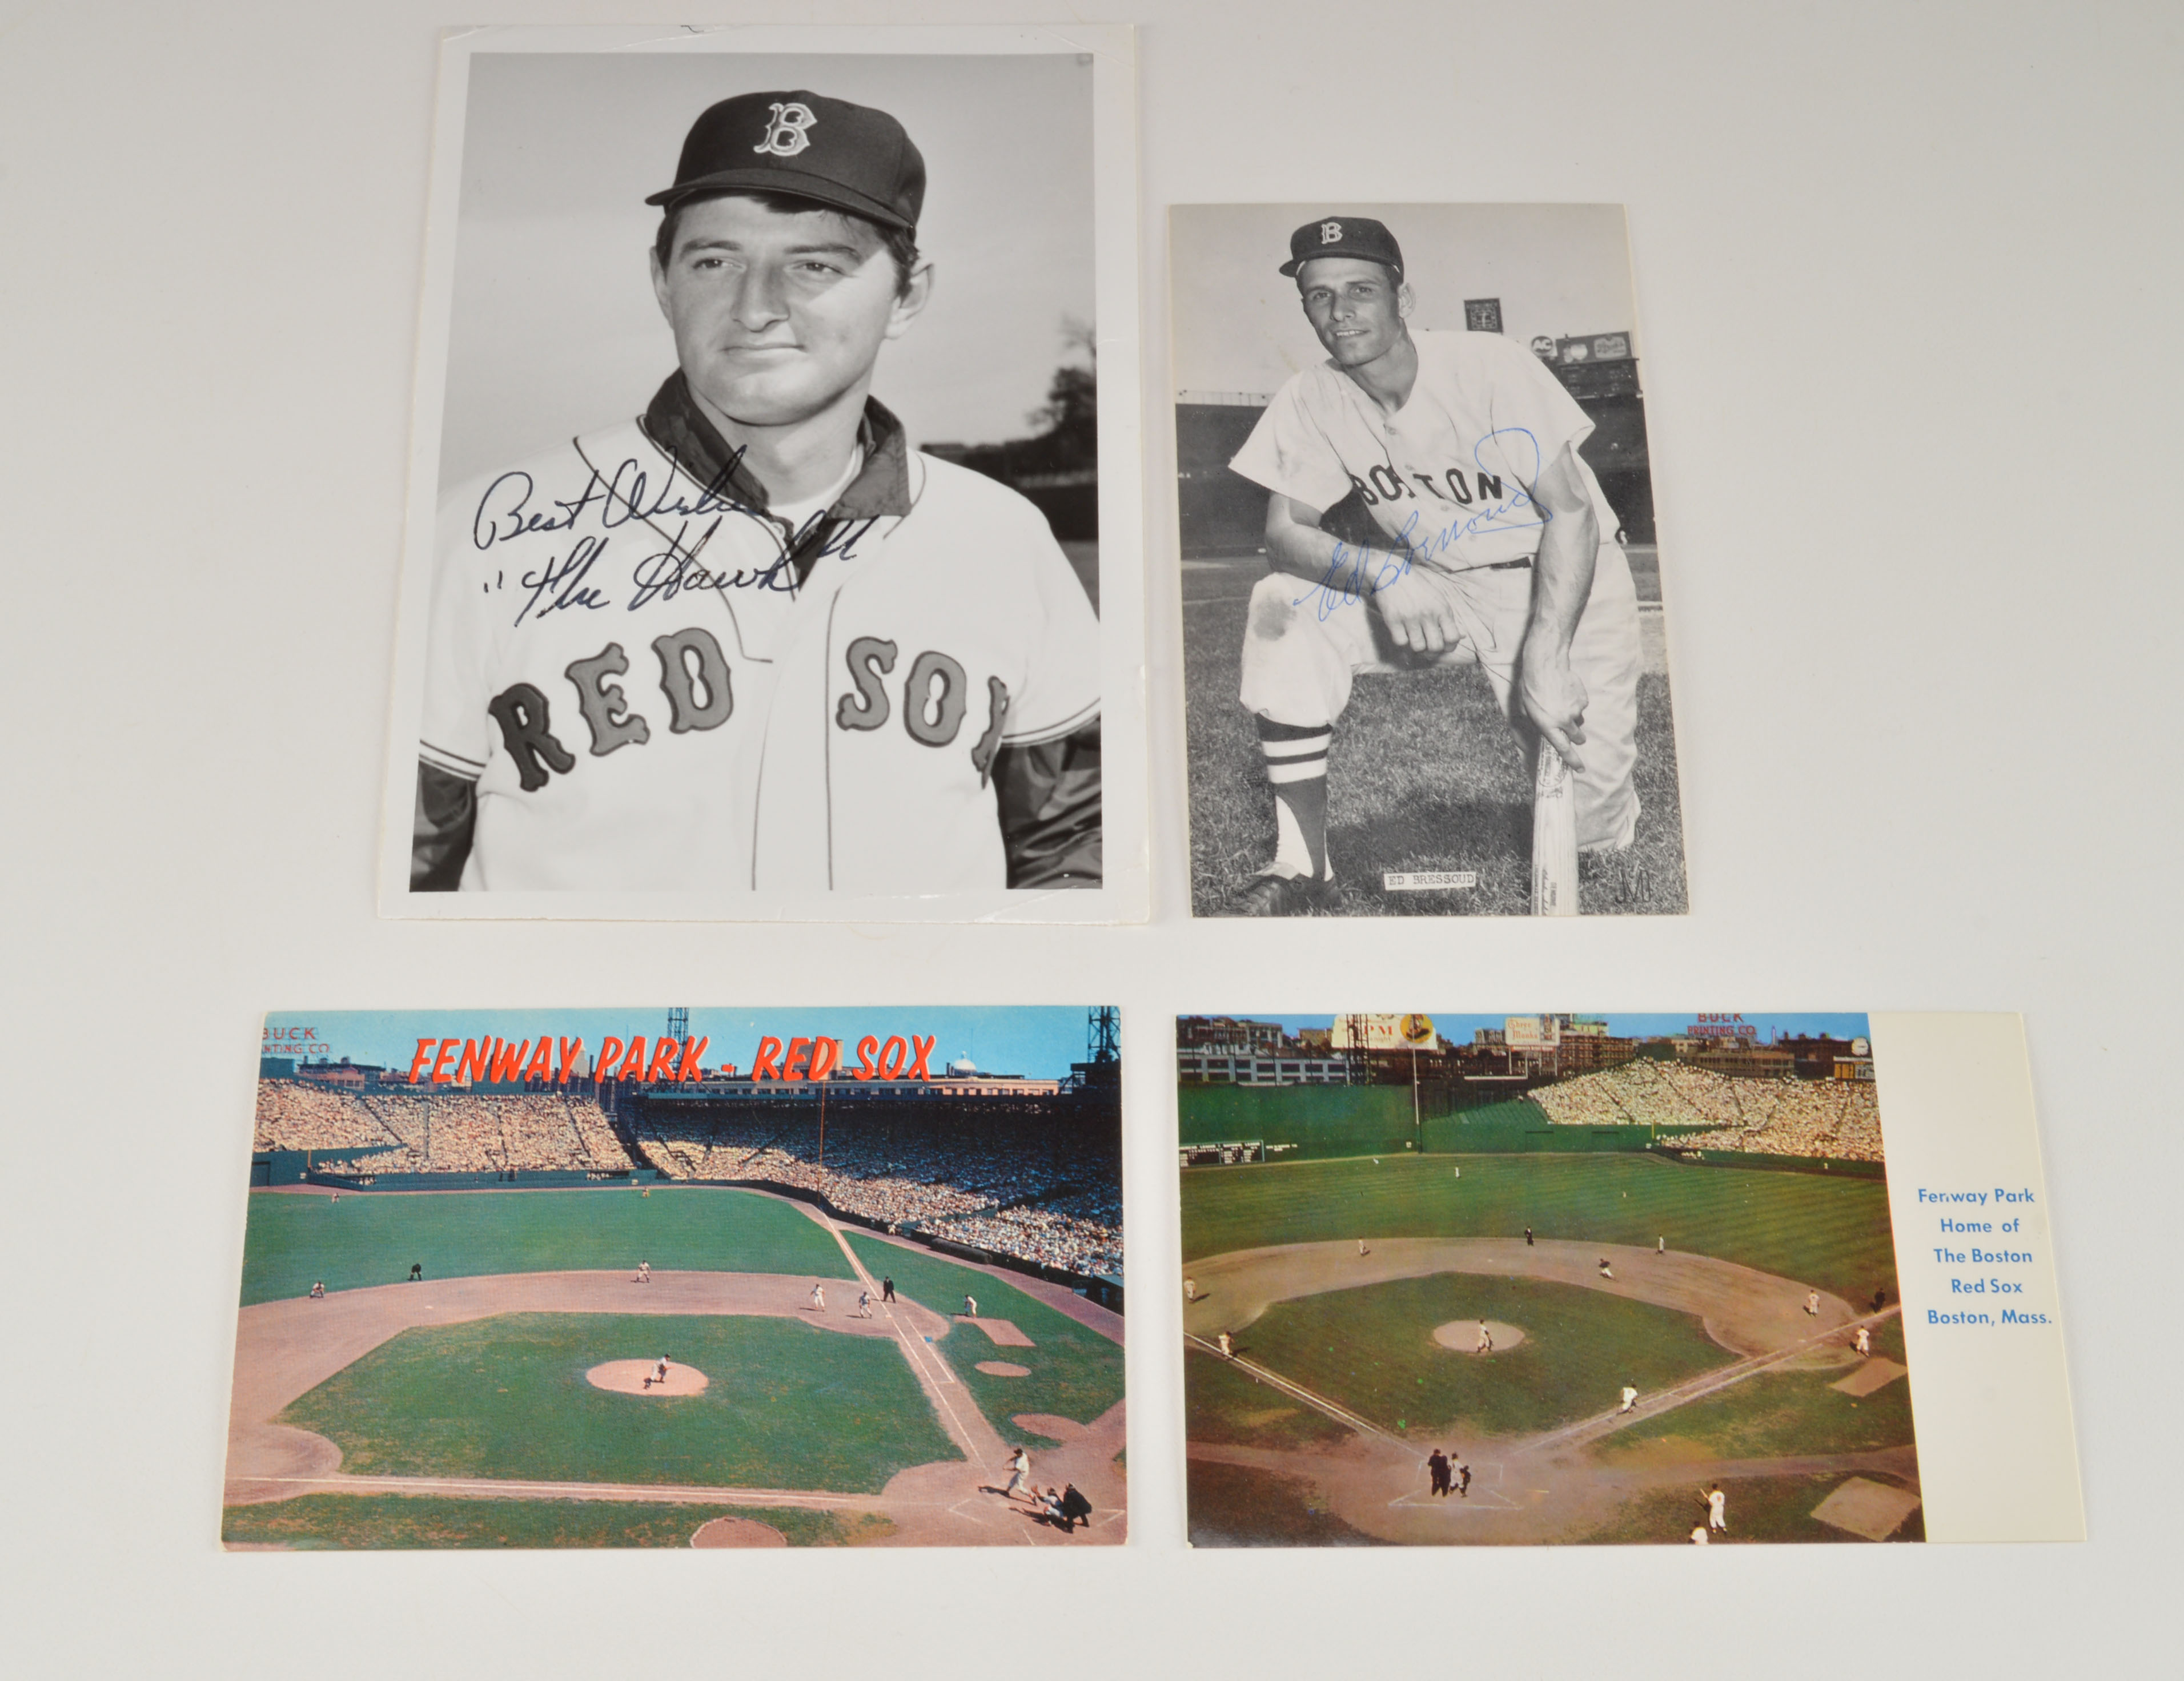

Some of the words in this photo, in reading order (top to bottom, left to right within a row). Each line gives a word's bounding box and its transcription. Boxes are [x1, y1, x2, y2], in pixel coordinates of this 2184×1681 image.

[753, 102, 818, 156] B
[1320, 221, 1342, 244] B
[473, 470, 607, 550] Best
[488, 628, 734, 792] RED
[1388, 875, 1404, 886] ED
[1413, 874, 1475, 884] BRESSOUD
[1687, 1026, 1735, 1036] PRINTING
[408, 1035, 581, 1084] FENWAY
[595, 1035, 708, 1084] PARK
[752, 1035, 837, 1082] RED
[853, 1035, 935, 1082] SOX
[1918, 1188, 1988, 1206] Fenway
[1994, 1188, 2035, 1203] Park
[1940, 1218, 1993, 1232] Home
[2001, 1218, 2020, 1233] of
[1934, 1248, 1966, 1263] The
[1972, 1248, 2033, 1263] Boston
[1951, 1278, 1985, 1293] Red
[1990, 1278, 2023, 1293] Sox
[1928, 1309, 1995, 1326] Boston,
[2001, 1309, 2053, 1324] Mass.
